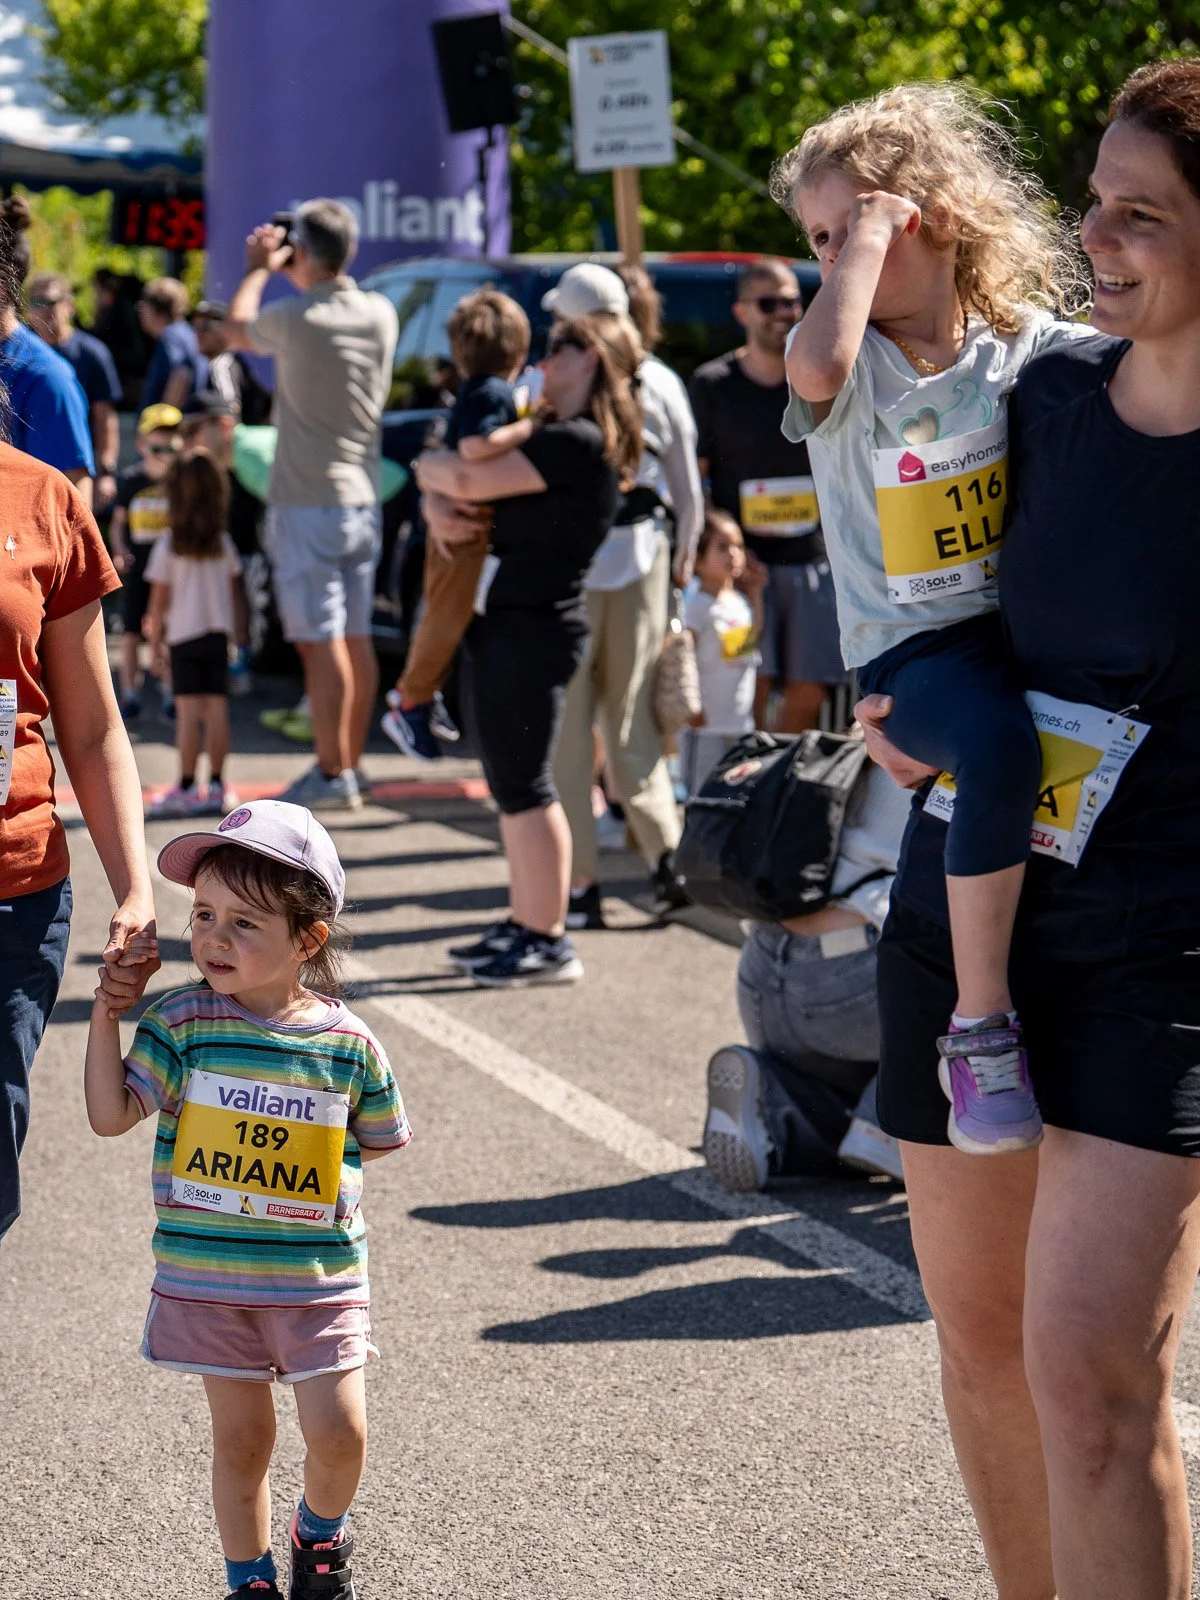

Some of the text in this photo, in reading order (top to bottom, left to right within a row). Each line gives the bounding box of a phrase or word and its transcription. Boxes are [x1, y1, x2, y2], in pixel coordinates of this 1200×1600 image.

[290, 179, 485, 246] liant
[945, 471, 1002, 512] 116
[1094, 773, 1109, 785] 116
[218, 1085, 316, 1121] valiant
[234, 1121, 289, 1151] 189
[185, 1147, 321, 1196] ARIANA
